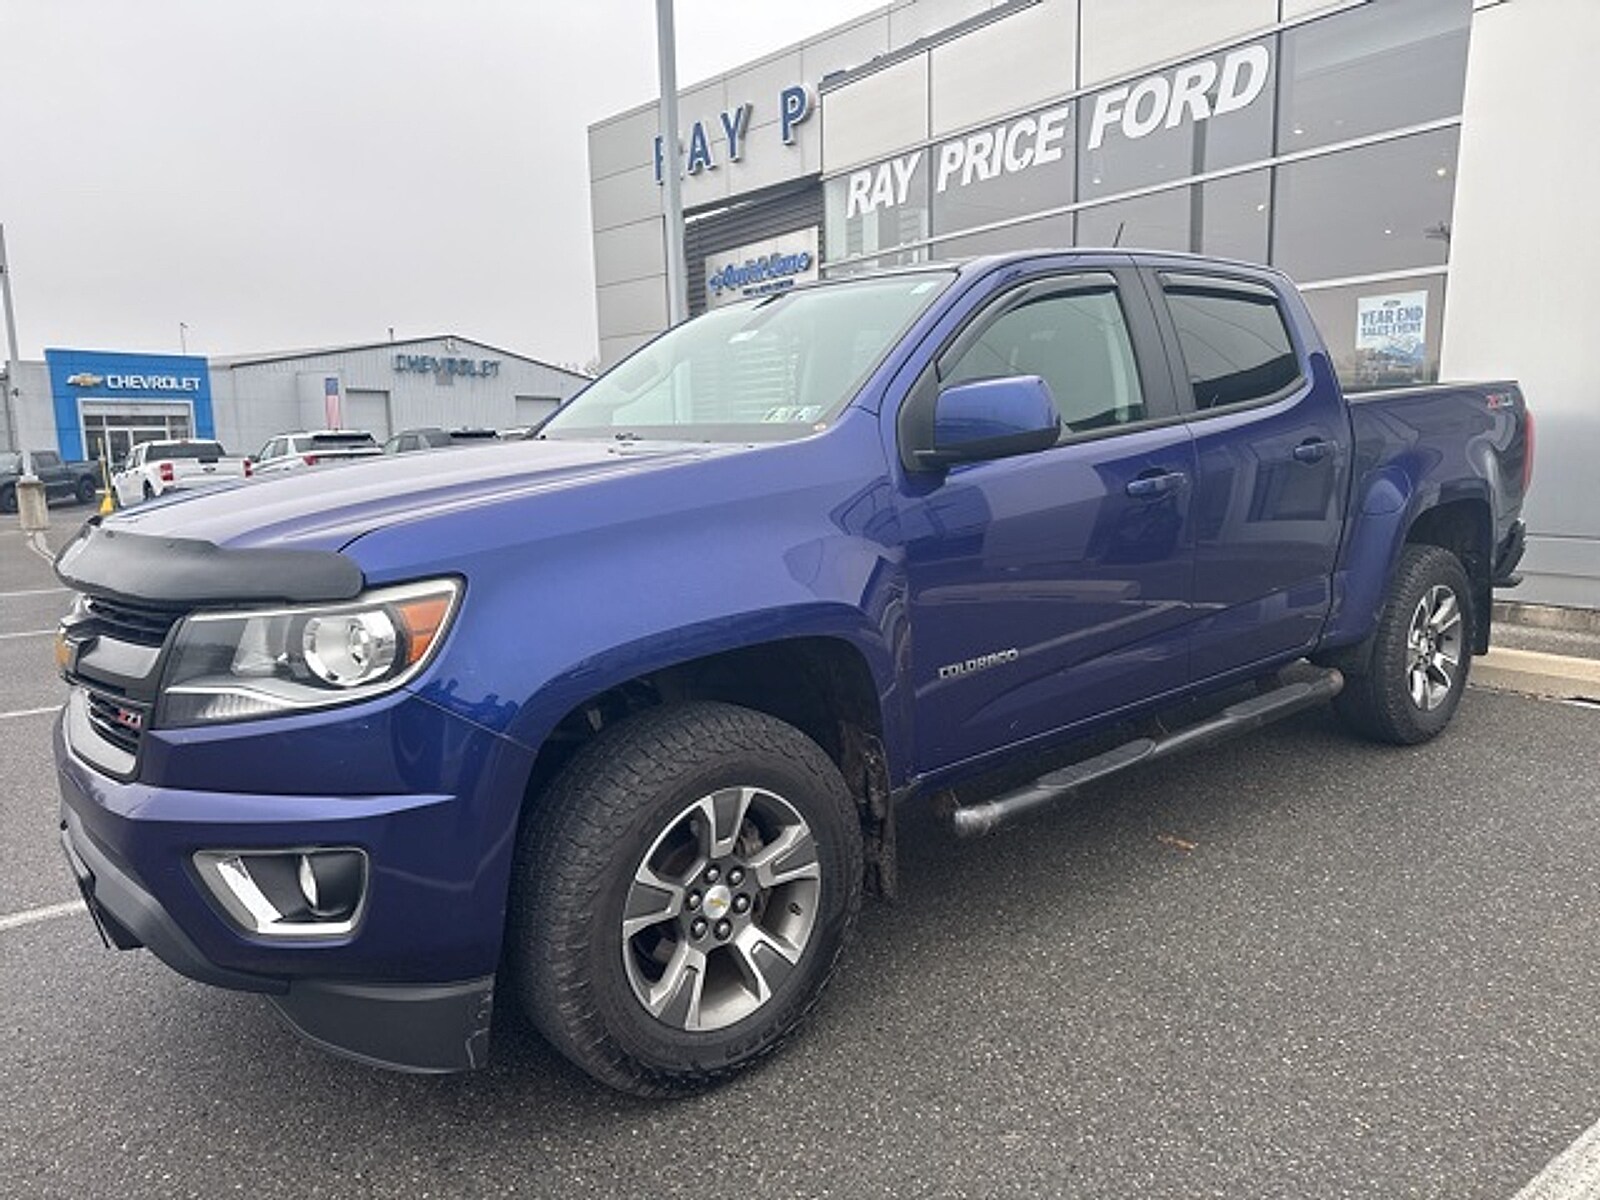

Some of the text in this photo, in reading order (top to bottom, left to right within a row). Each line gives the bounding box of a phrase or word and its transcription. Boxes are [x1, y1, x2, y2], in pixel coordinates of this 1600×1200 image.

[846, 44, 1269, 219] RAY PRICE FORD
[1360, 305, 1423, 326] YEAR END
[394, 355, 501, 377] CHEVROLET
[106, 374, 201, 391] CHEVROLET
[939, 648, 1019, 678] COLORADO
